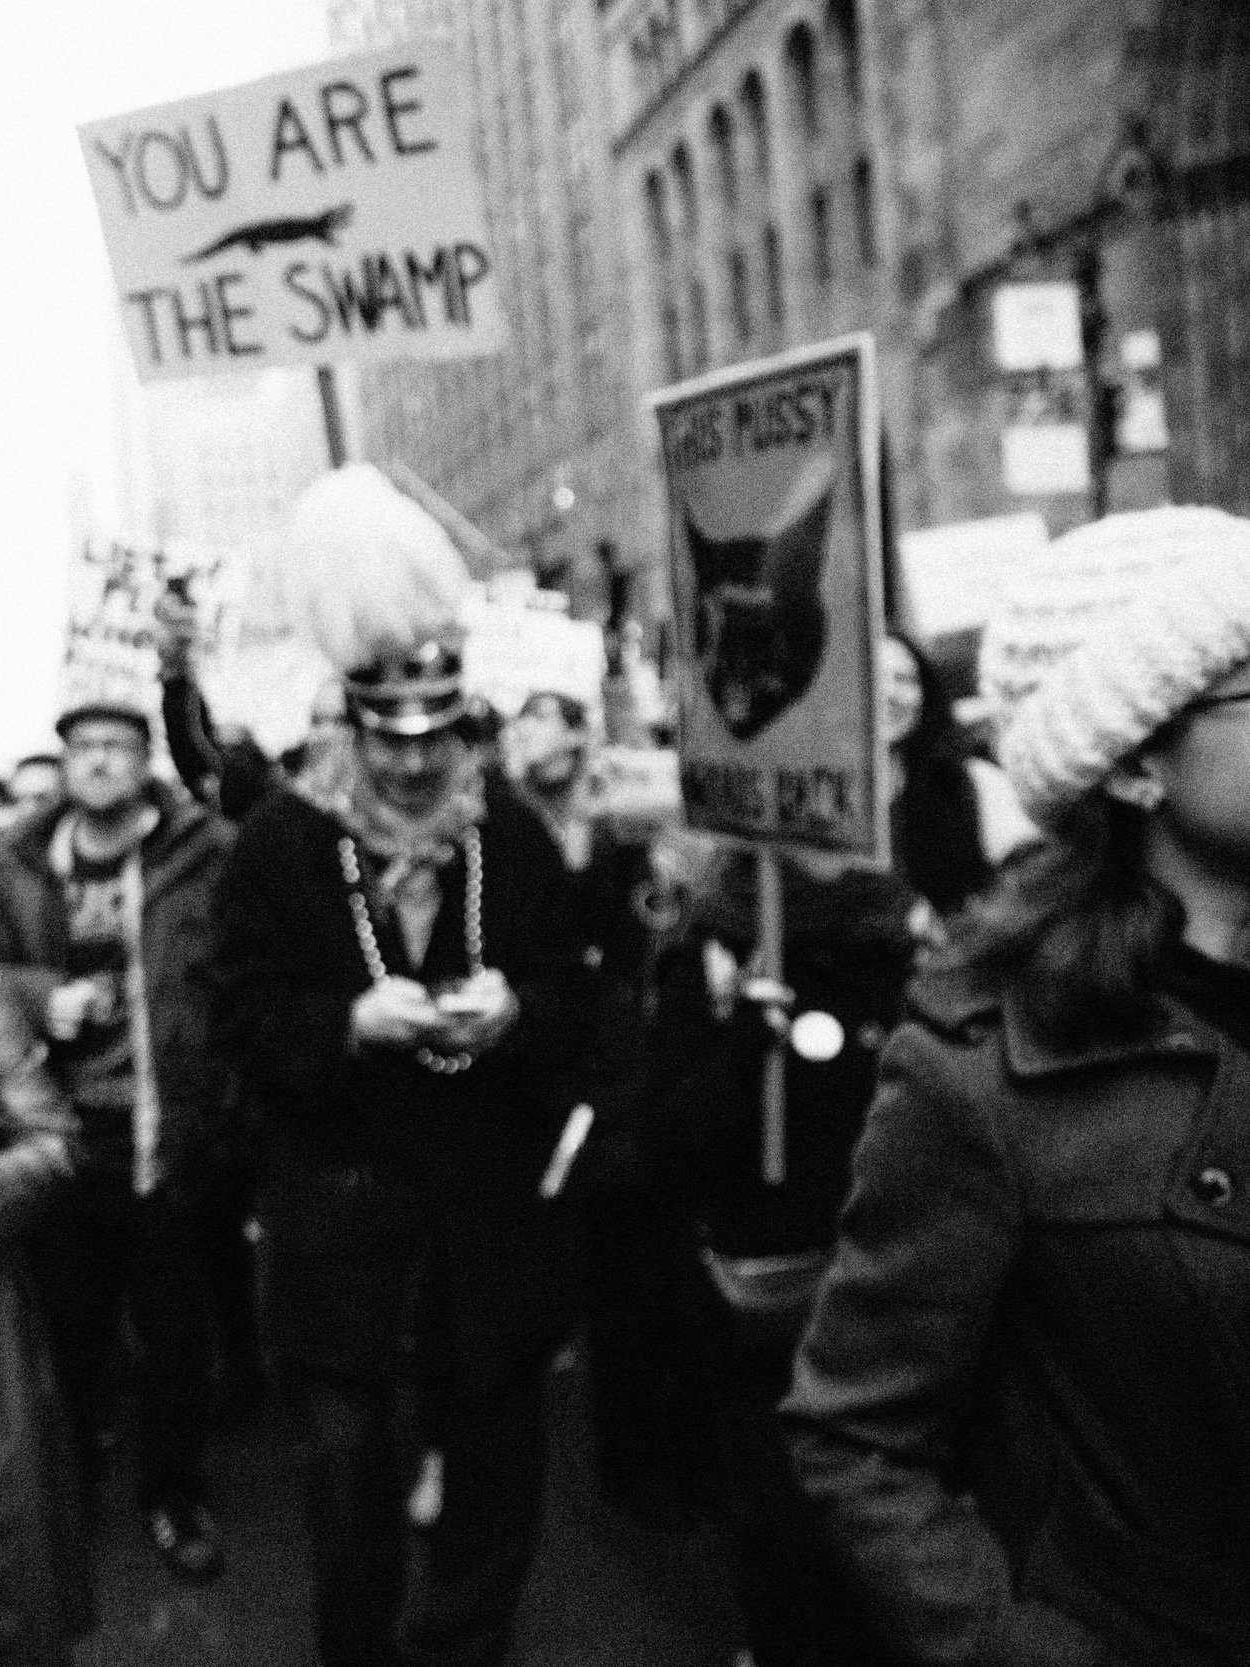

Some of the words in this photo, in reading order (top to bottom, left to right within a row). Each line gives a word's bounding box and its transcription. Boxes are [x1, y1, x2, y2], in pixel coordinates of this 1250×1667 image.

[90, 114, 230, 216] YOU
[267, 63, 439, 181] ARE
[122, 272, 265, 364] THE
[284, 242, 490, 343] SWAMP
